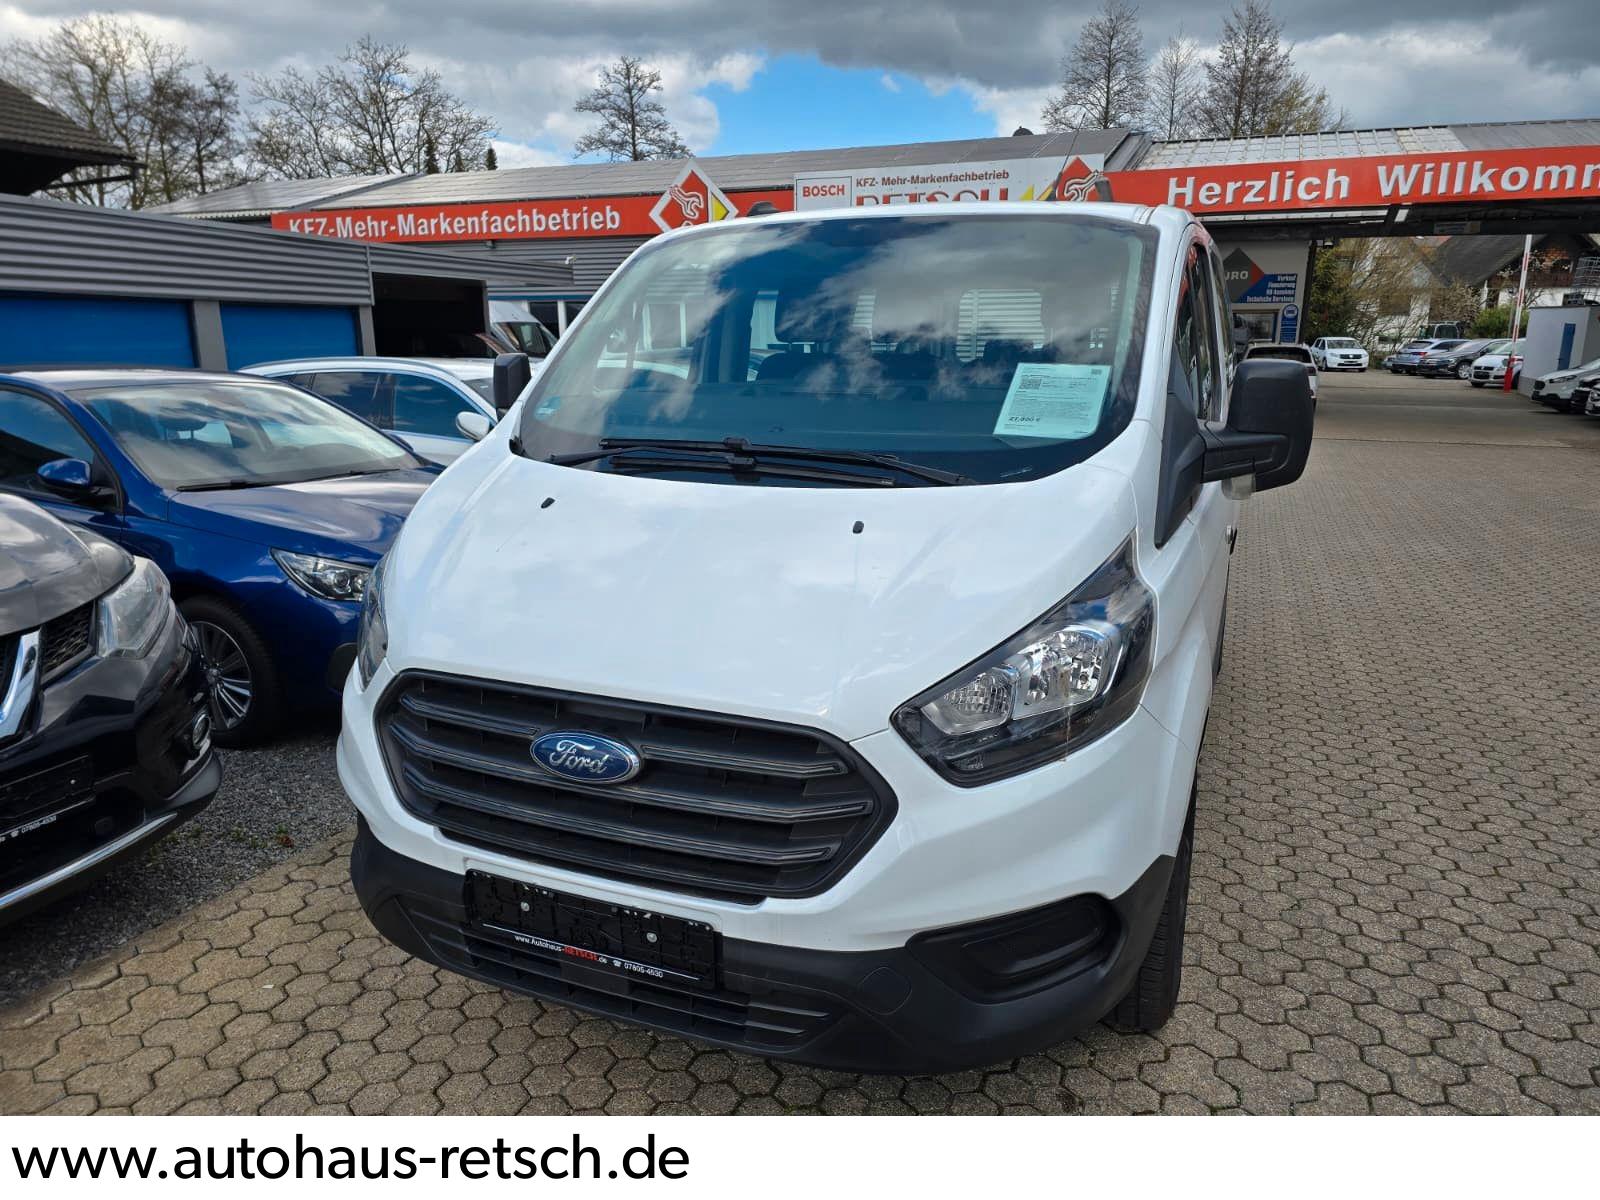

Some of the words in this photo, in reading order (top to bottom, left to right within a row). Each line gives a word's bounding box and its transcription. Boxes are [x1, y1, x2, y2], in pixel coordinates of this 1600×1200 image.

[802, 184, 845, 198] BOSCH
[856, 177, 879, 188] KFZ-
[881, 169, 1009, 187] Mehr-Markenfachbetrieb
[1167, 168, 1350, 206] Herzlich
[289, 205, 620, 239] KFZ-Mehr-Markenfachbetrieb
[1224, 270, 1249, 281] URO
[549, 739, 610, 774] Ford
